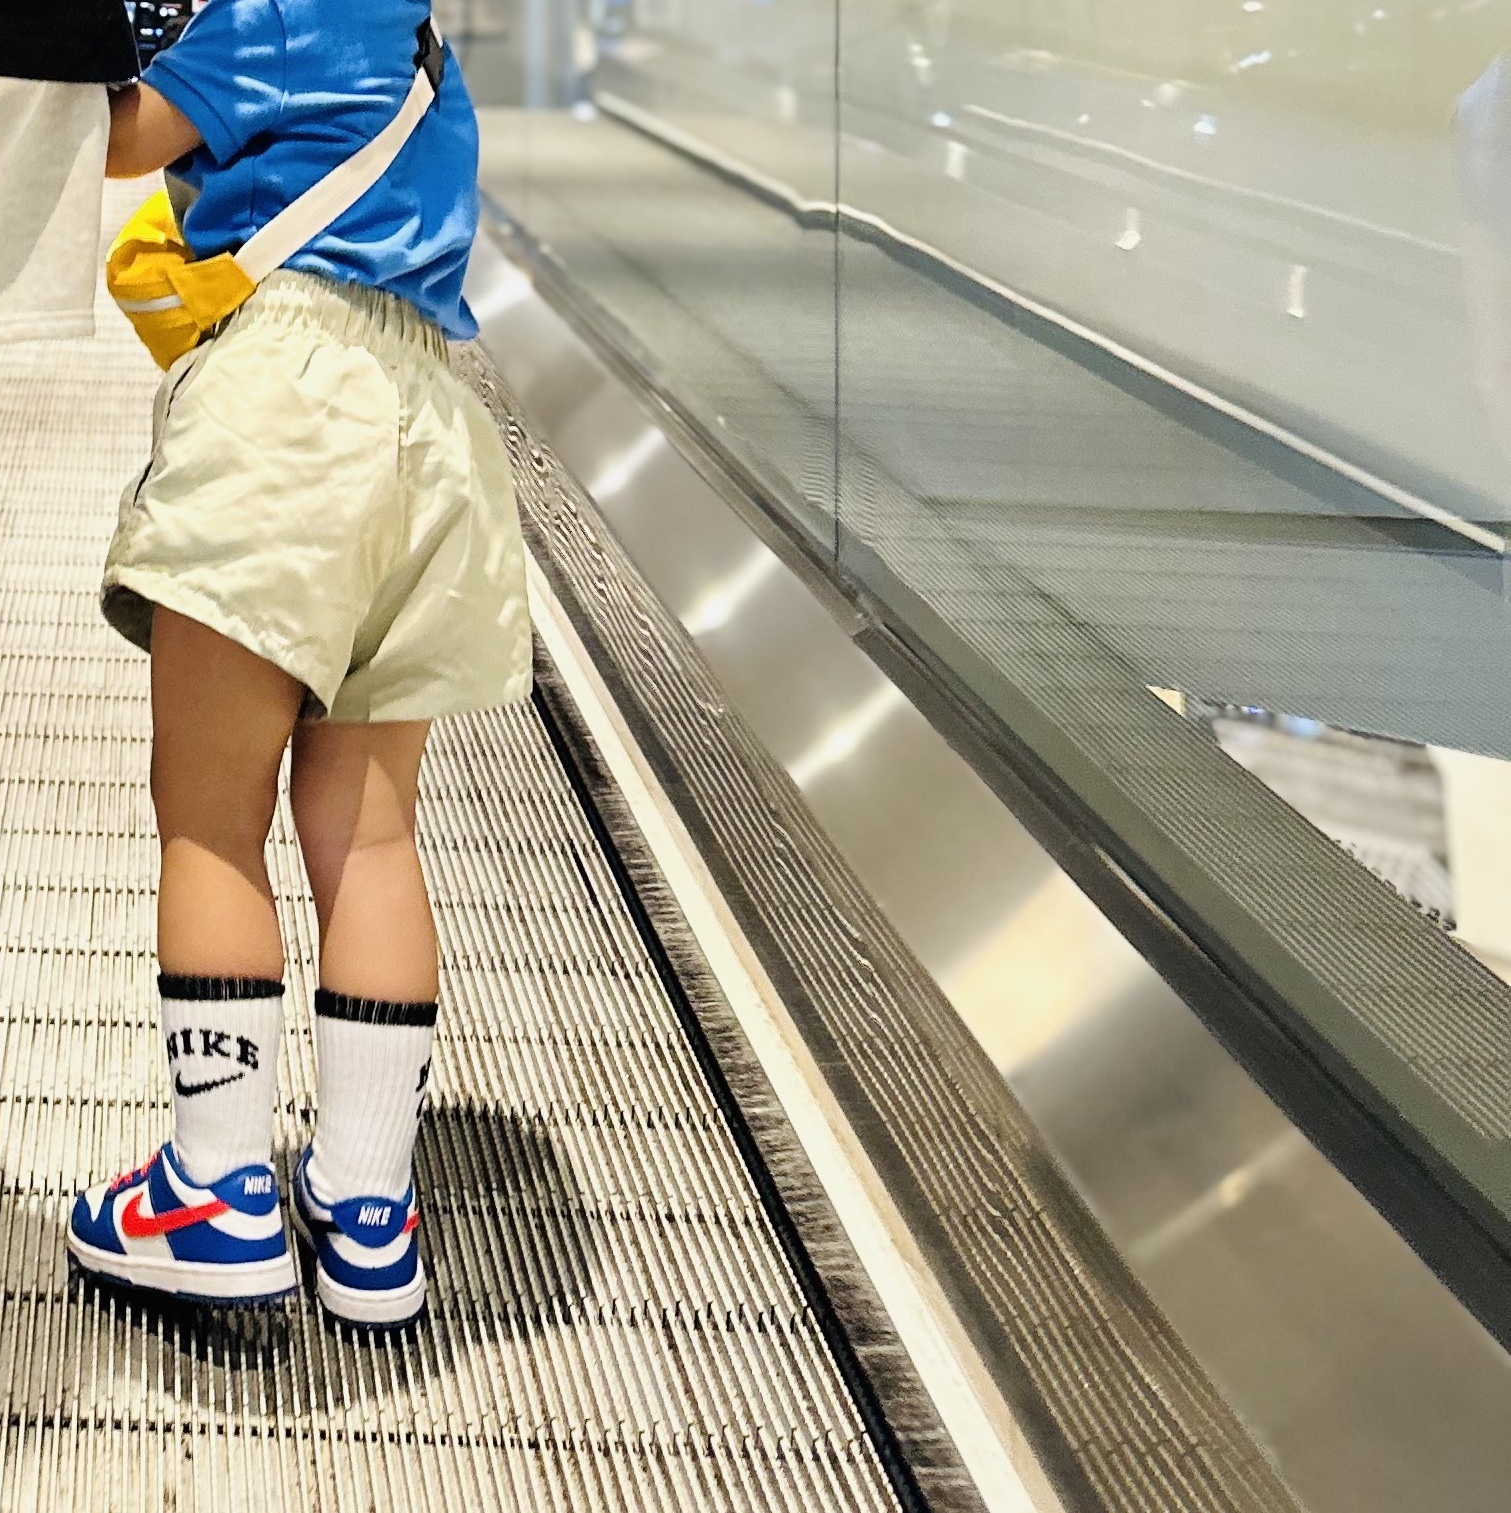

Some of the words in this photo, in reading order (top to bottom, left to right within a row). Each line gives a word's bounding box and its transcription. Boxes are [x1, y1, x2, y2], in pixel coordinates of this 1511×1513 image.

[166, 1027, 259, 1071] NIKE
[244, 1174, 272, 1196] NIKE
[357, 1205, 392, 1227] NIKE
